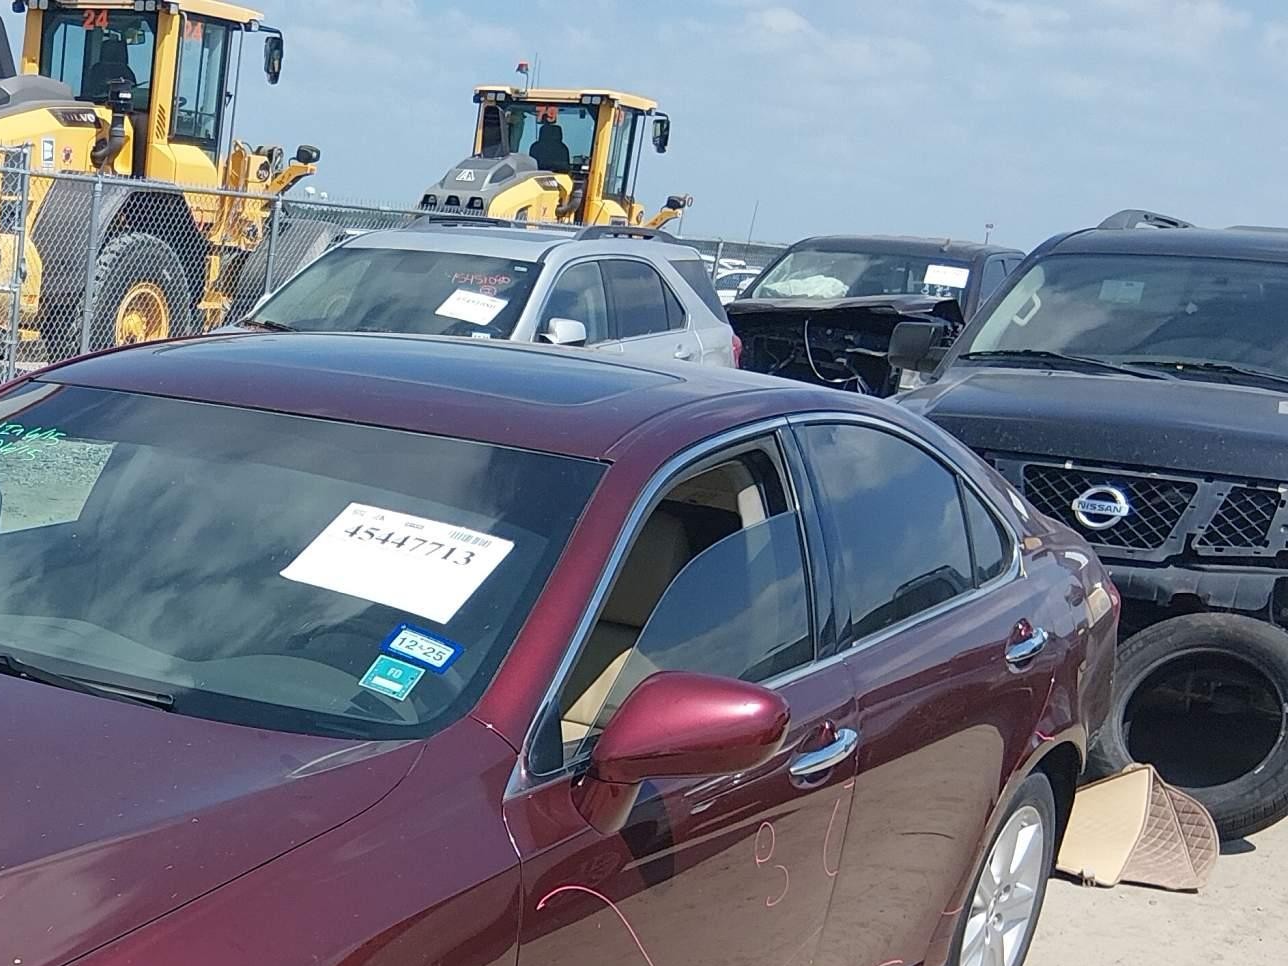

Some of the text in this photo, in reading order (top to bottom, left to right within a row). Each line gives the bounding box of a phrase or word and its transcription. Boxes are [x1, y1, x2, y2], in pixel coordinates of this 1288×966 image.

[83, 9, 109, 31] 24
[536, 105, 558, 123] 79
[1077, 500, 1122, 513] NISSAN
[344, 524, 476, 566] 45447713
